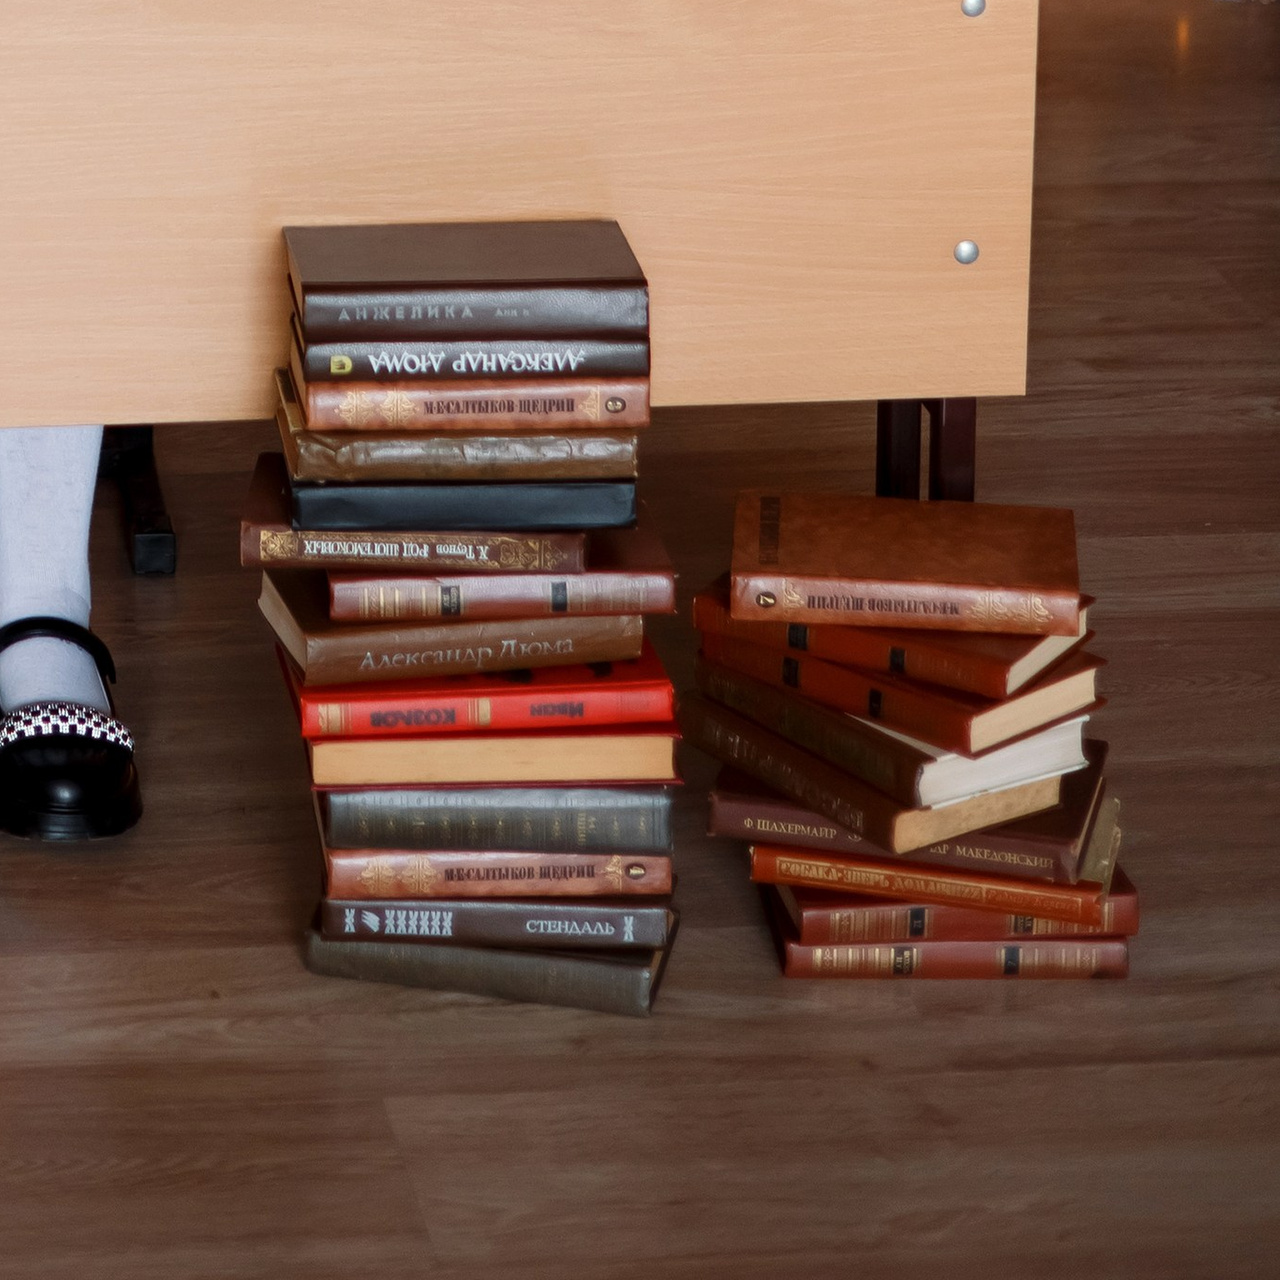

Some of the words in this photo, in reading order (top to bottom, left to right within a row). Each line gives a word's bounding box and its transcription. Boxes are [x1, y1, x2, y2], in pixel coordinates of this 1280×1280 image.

[338, 303, 474, 322] АНЖЕЛИКА
[367, 350, 446, 374] ДЮМА
[452, 349, 586, 372] АЛЕКСАНДР
[358, 646, 492, 671] Александр
[499, 638, 575, 659] Дюма
[525, 919, 616, 936] СТЕНДАЛЬ
